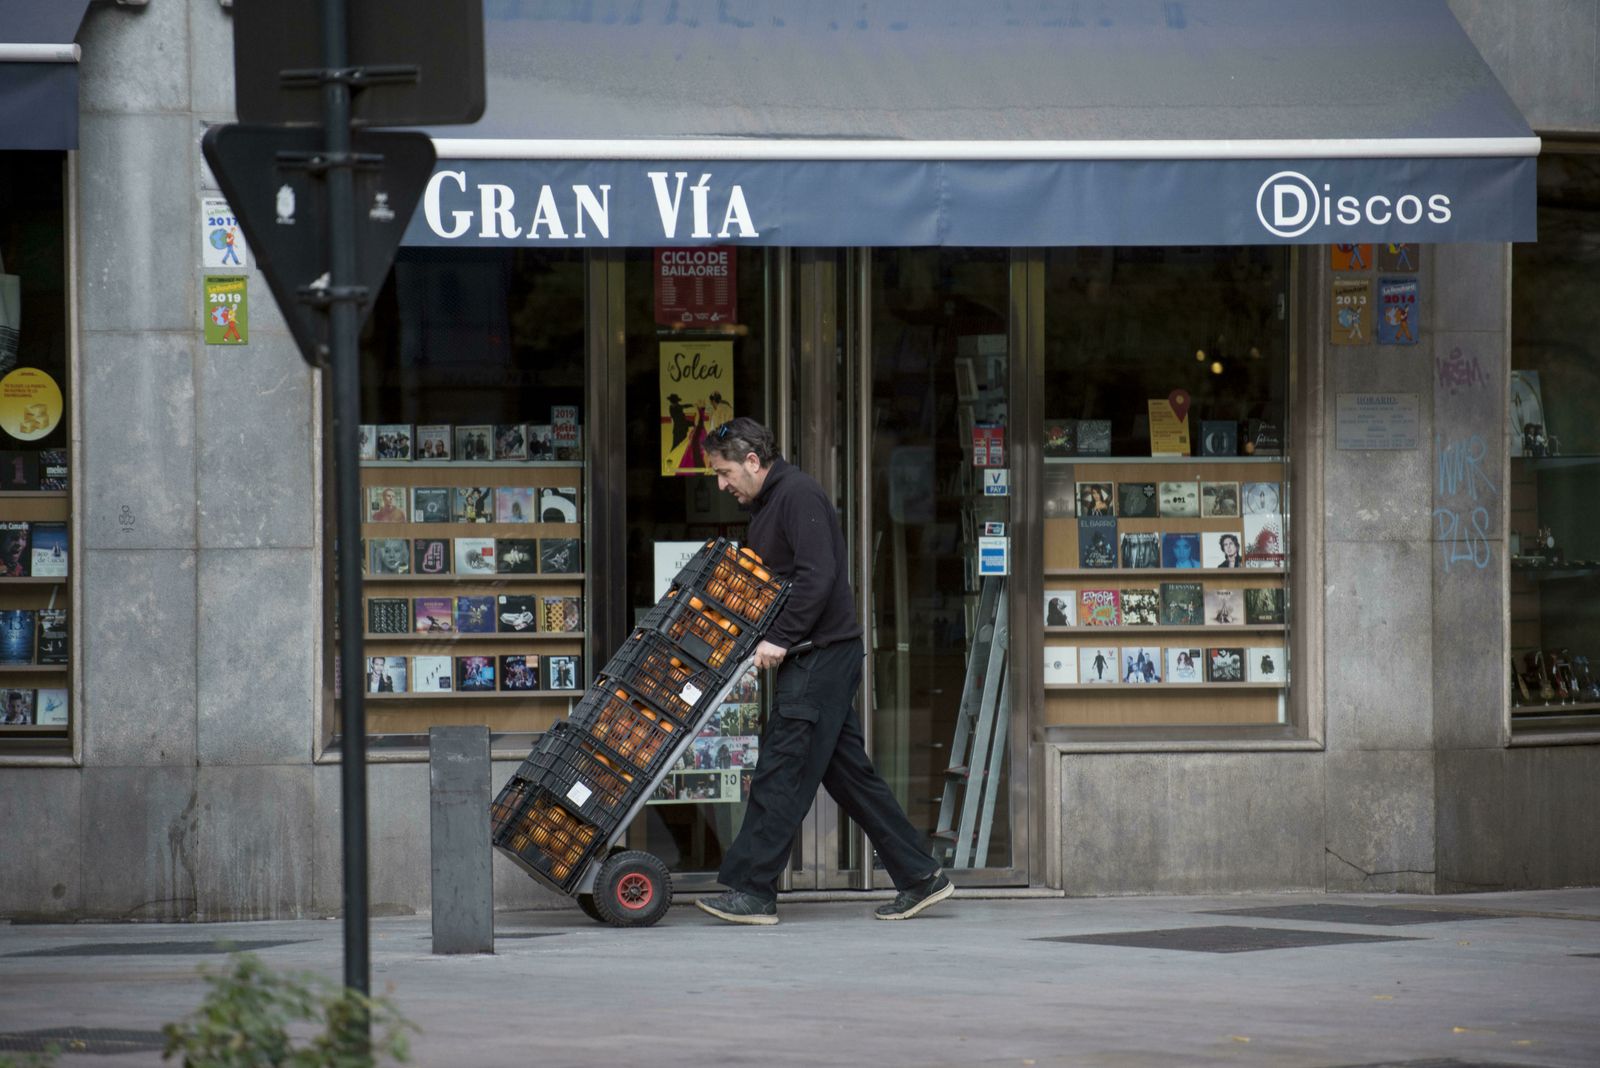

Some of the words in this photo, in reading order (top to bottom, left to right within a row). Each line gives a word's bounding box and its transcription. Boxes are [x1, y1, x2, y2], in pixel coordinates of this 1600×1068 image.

[424, 171, 611, 239] GRAN
[647, 171, 759, 239] VÍA
[661, 251, 706, 265] CICLO
[707, 251, 728, 265] DE
[661, 265, 728, 277] BAILAORES
[724, 774, 737, 785] 10
